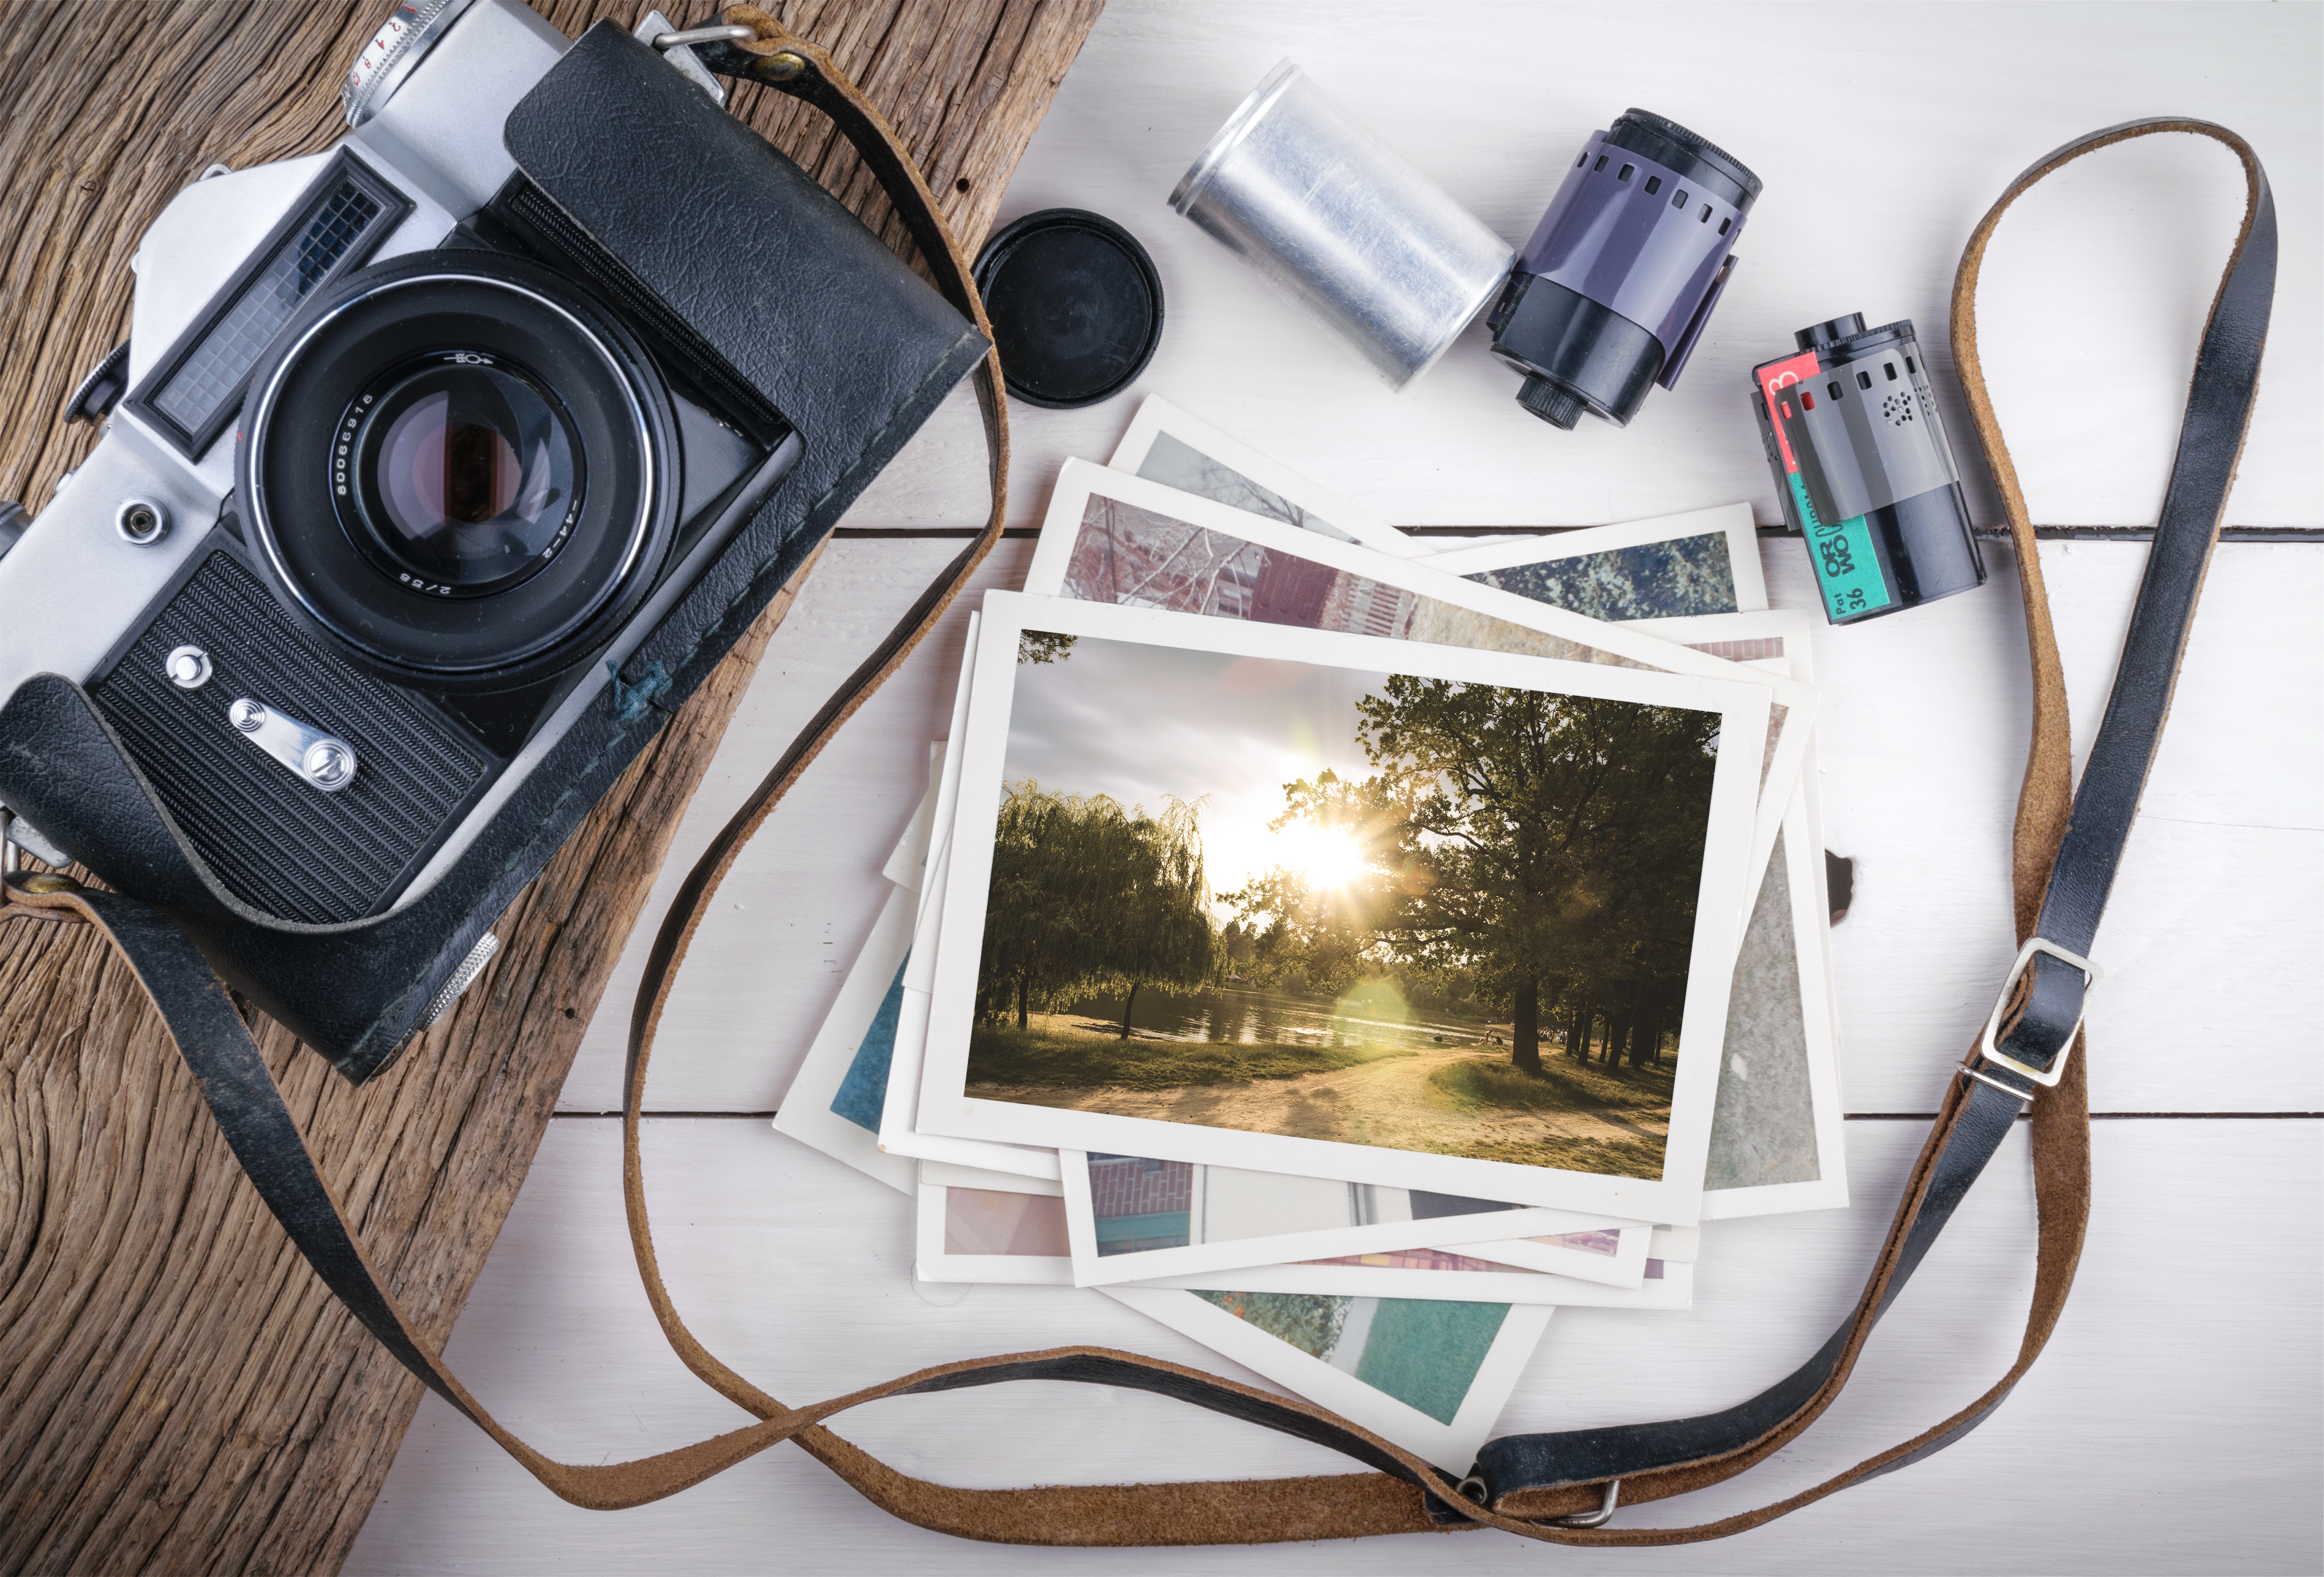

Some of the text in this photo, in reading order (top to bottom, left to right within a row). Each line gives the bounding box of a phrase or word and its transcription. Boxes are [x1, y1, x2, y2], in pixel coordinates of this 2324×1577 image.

[392, 23, 401, 31] 2
[364, 59, 371, 68] 8
[336, 394, 373, 495] 80066918
[1819, 539, 1840, 577] OR
[1834, 534, 1855, 575] WO
[400, 573, 451, 594] 2/58
[1834, 593, 1846, 614] Pat
[1847, 588, 1866, 609] 36
